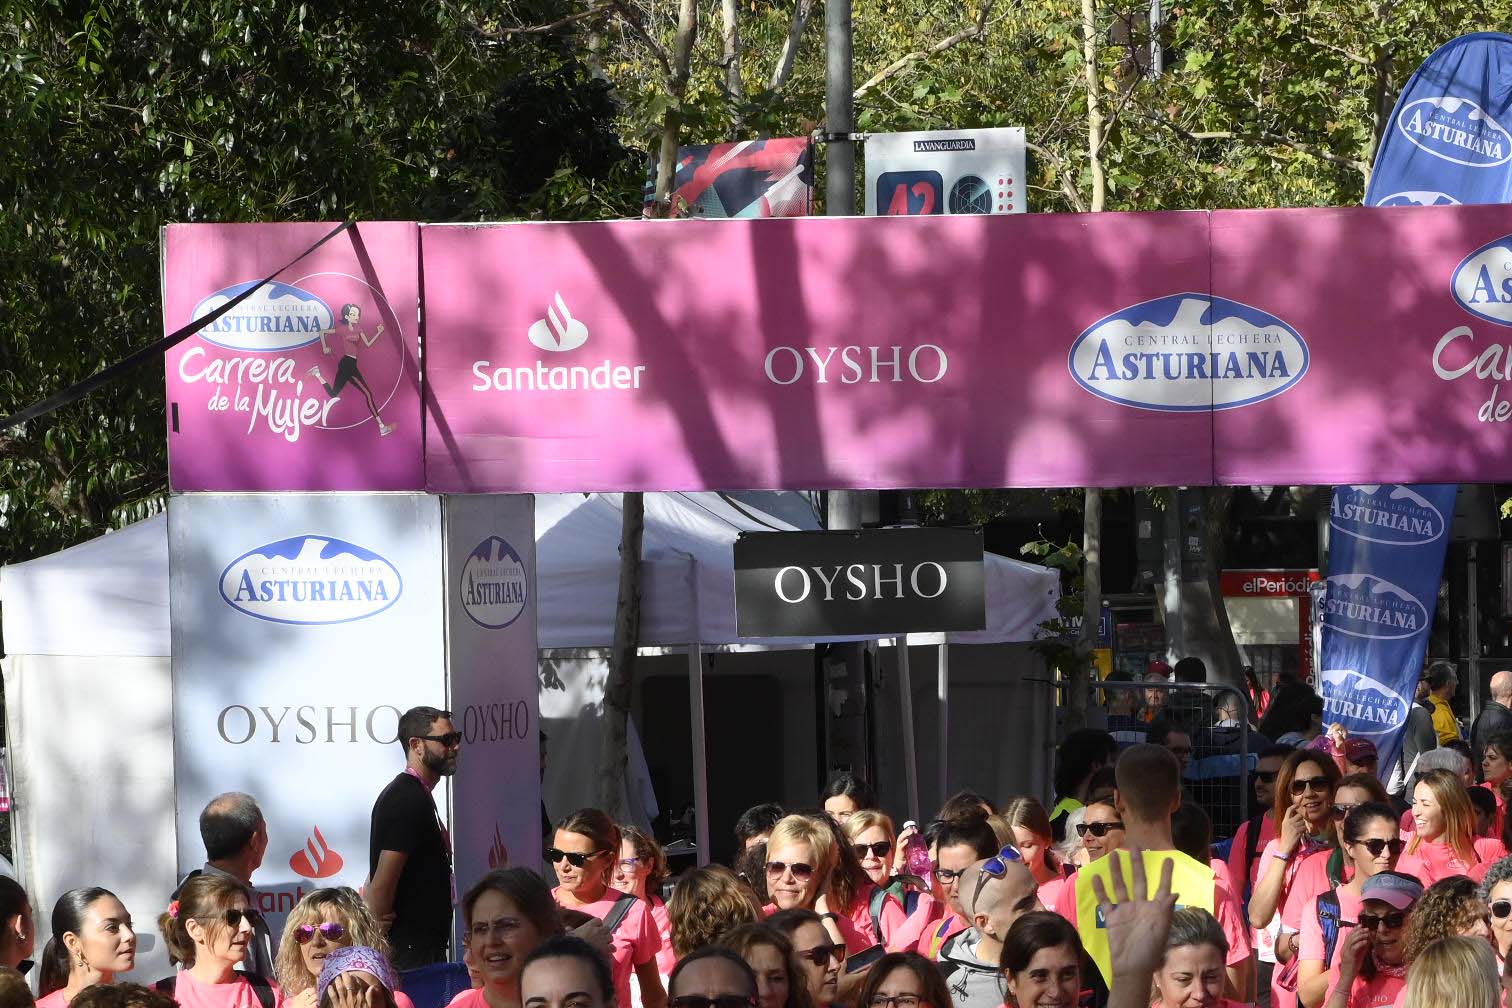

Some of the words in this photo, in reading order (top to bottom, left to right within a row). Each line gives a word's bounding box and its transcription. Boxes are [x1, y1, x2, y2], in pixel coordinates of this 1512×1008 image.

[1405, 108, 1503, 160] ASTURIANA
[1124, 335, 1199, 346] CENTRAL
[1207, 332, 1282, 344] LECHERA
[178, 346, 297, 384] Carrera
[472, 360, 646, 392] Santander
[763, 344, 948, 386] OYSHO
[1087, 338, 1290, 381] ASTURIANA
[207, 386, 230, 412] de
[233, 386, 250, 412] la
[247, 380, 341, 443] Mujer
[1477, 383, 1512, 423] de
[1330, 492, 1433, 536] ASTURIANA
[234, 568, 389, 603] ASTURIANA
[466, 569, 524, 606] ASTURIANA
[773, 561, 948, 603] OYSHO
[1325, 598, 1417, 631] STURIANA
[217, 704, 402, 745] OYSHO
[463, 700, 529, 745] OYSHO
[1322, 698, 1398, 725] TURIANA
